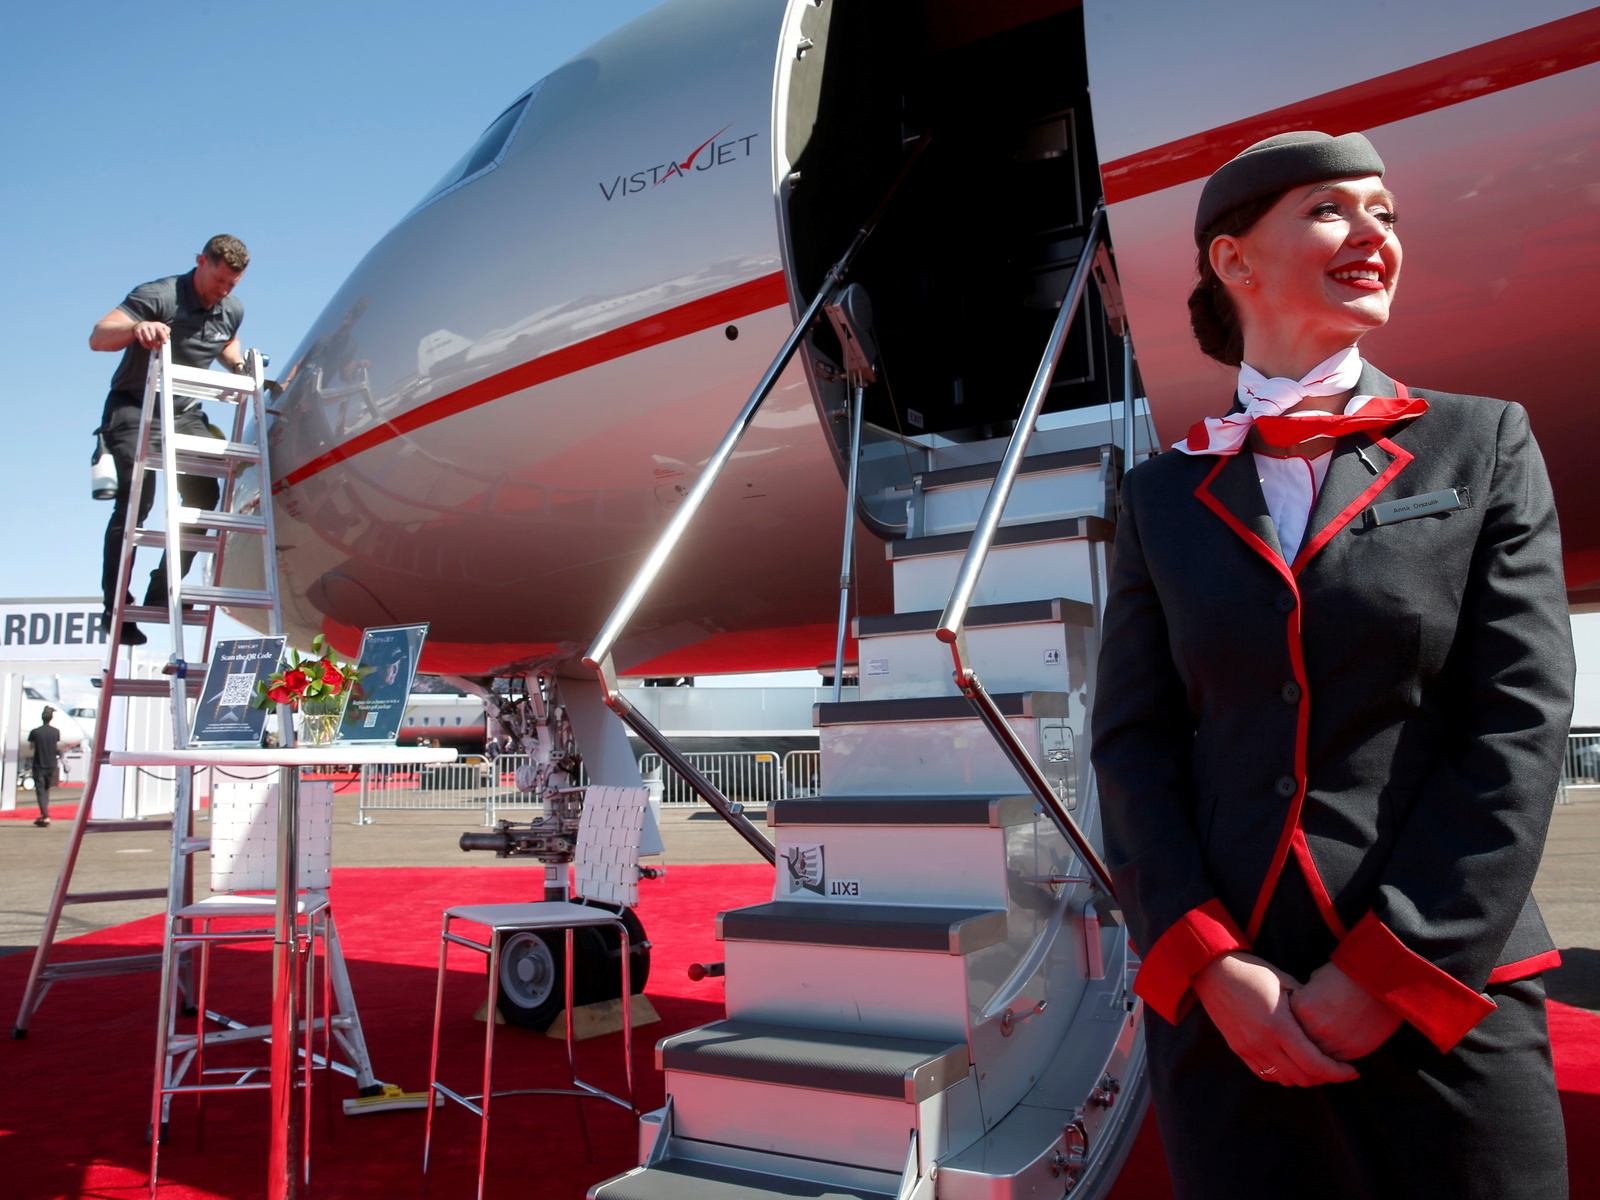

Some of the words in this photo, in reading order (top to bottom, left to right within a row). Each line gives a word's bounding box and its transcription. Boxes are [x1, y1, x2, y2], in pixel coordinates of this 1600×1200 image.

[1393, 506, 1411, 514] Anna
[0, 612, 107, 646] RDIER
[220, 653, 236, 661] Scan
[236, 652, 246, 660] the
[246, 652, 257, 661] QR
[257, 651, 273, 660] Code
[831, 881, 859, 896] EXIT
